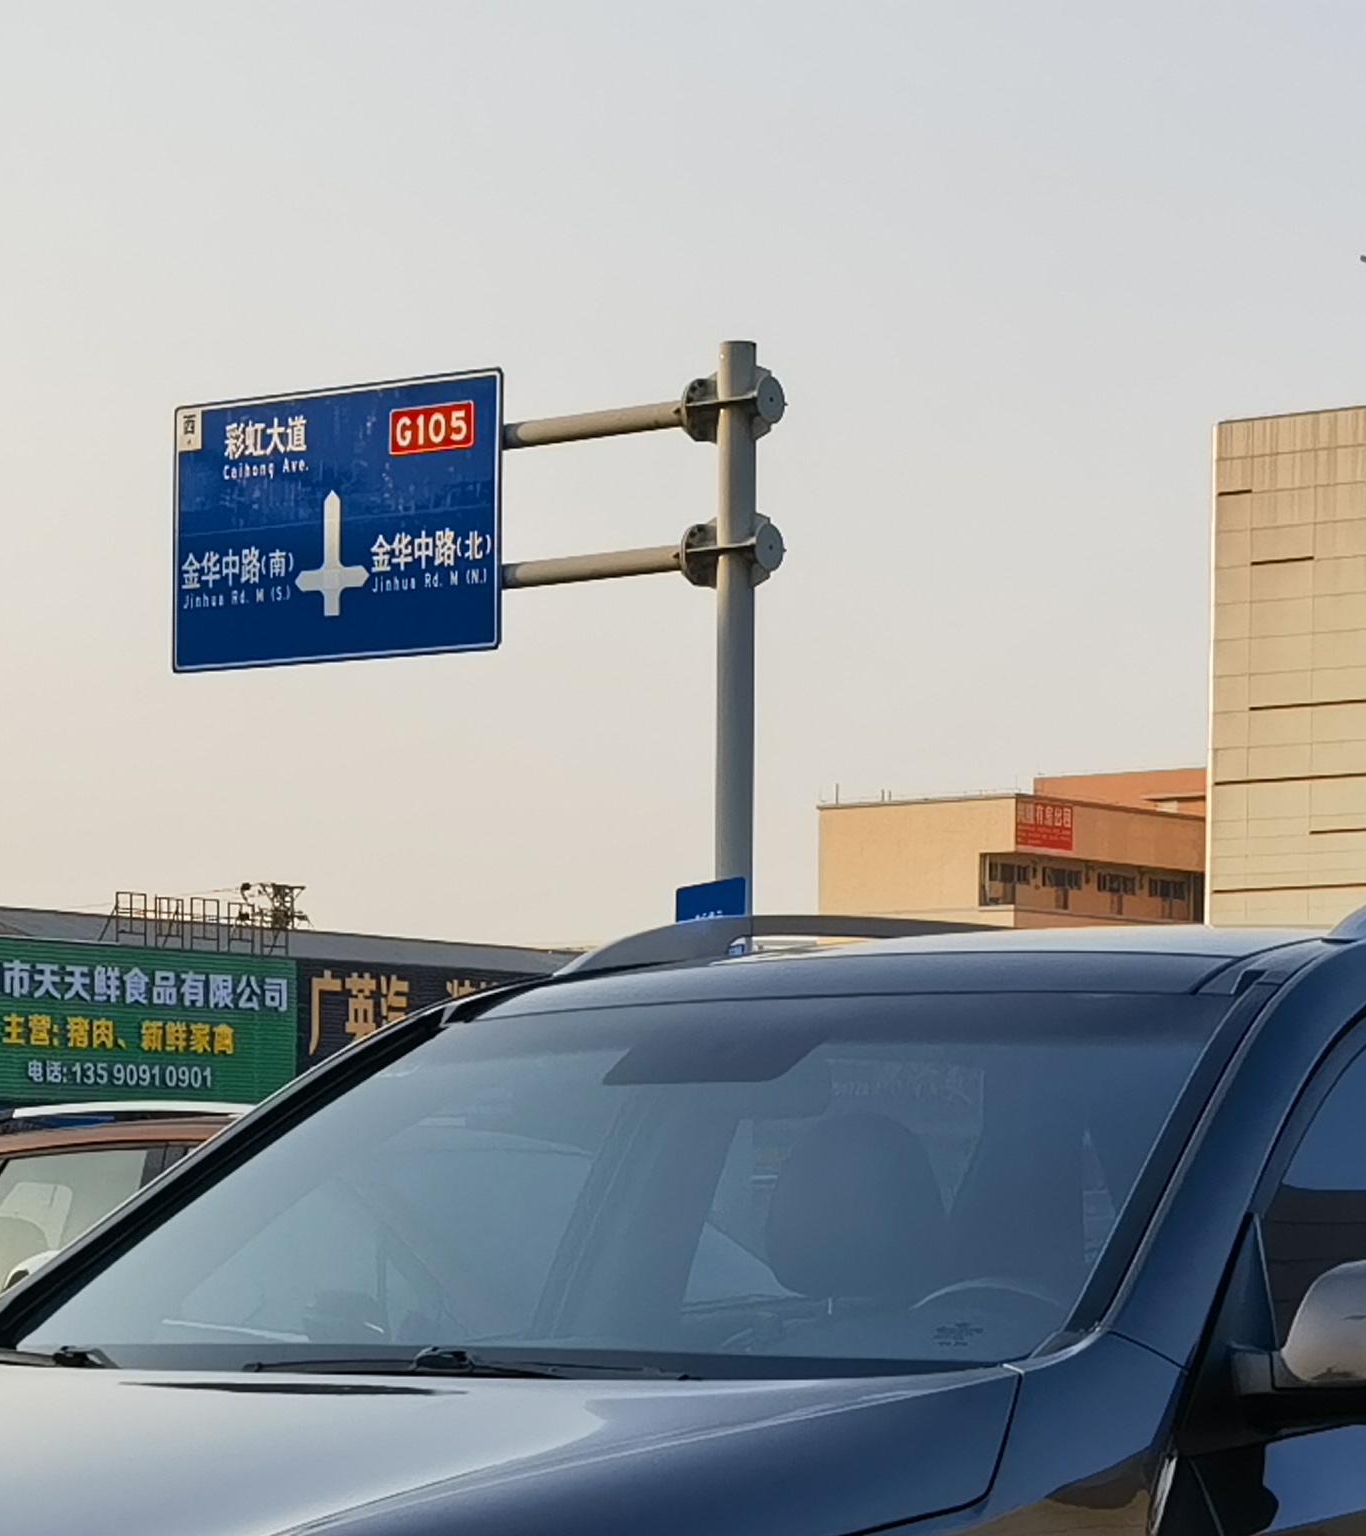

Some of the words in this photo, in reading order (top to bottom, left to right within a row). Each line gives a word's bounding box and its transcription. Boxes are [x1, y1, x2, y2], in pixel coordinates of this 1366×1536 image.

[183, 414, 196, 435] 西
[396, 410, 467, 447] G105
[224, 415, 307, 460] 彩虹大道
[223, 463, 275, 480] Caihong
[282, 458, 309, 474] Ave.
[370, 527, 492, 573] 金华中路(北)
[372, 574, 415, 593] Jinhua
[424, 572, 443, 588] Rd.
[450, 570, 458, 586] M
[466, 568, 487, 585] (N.)
[183, 592, 224, 609] Jinhua
[231, 589, 250, 605] Rd.
[256, 588, 265, 603] M
[270, 585, 291, 602] (S.)
